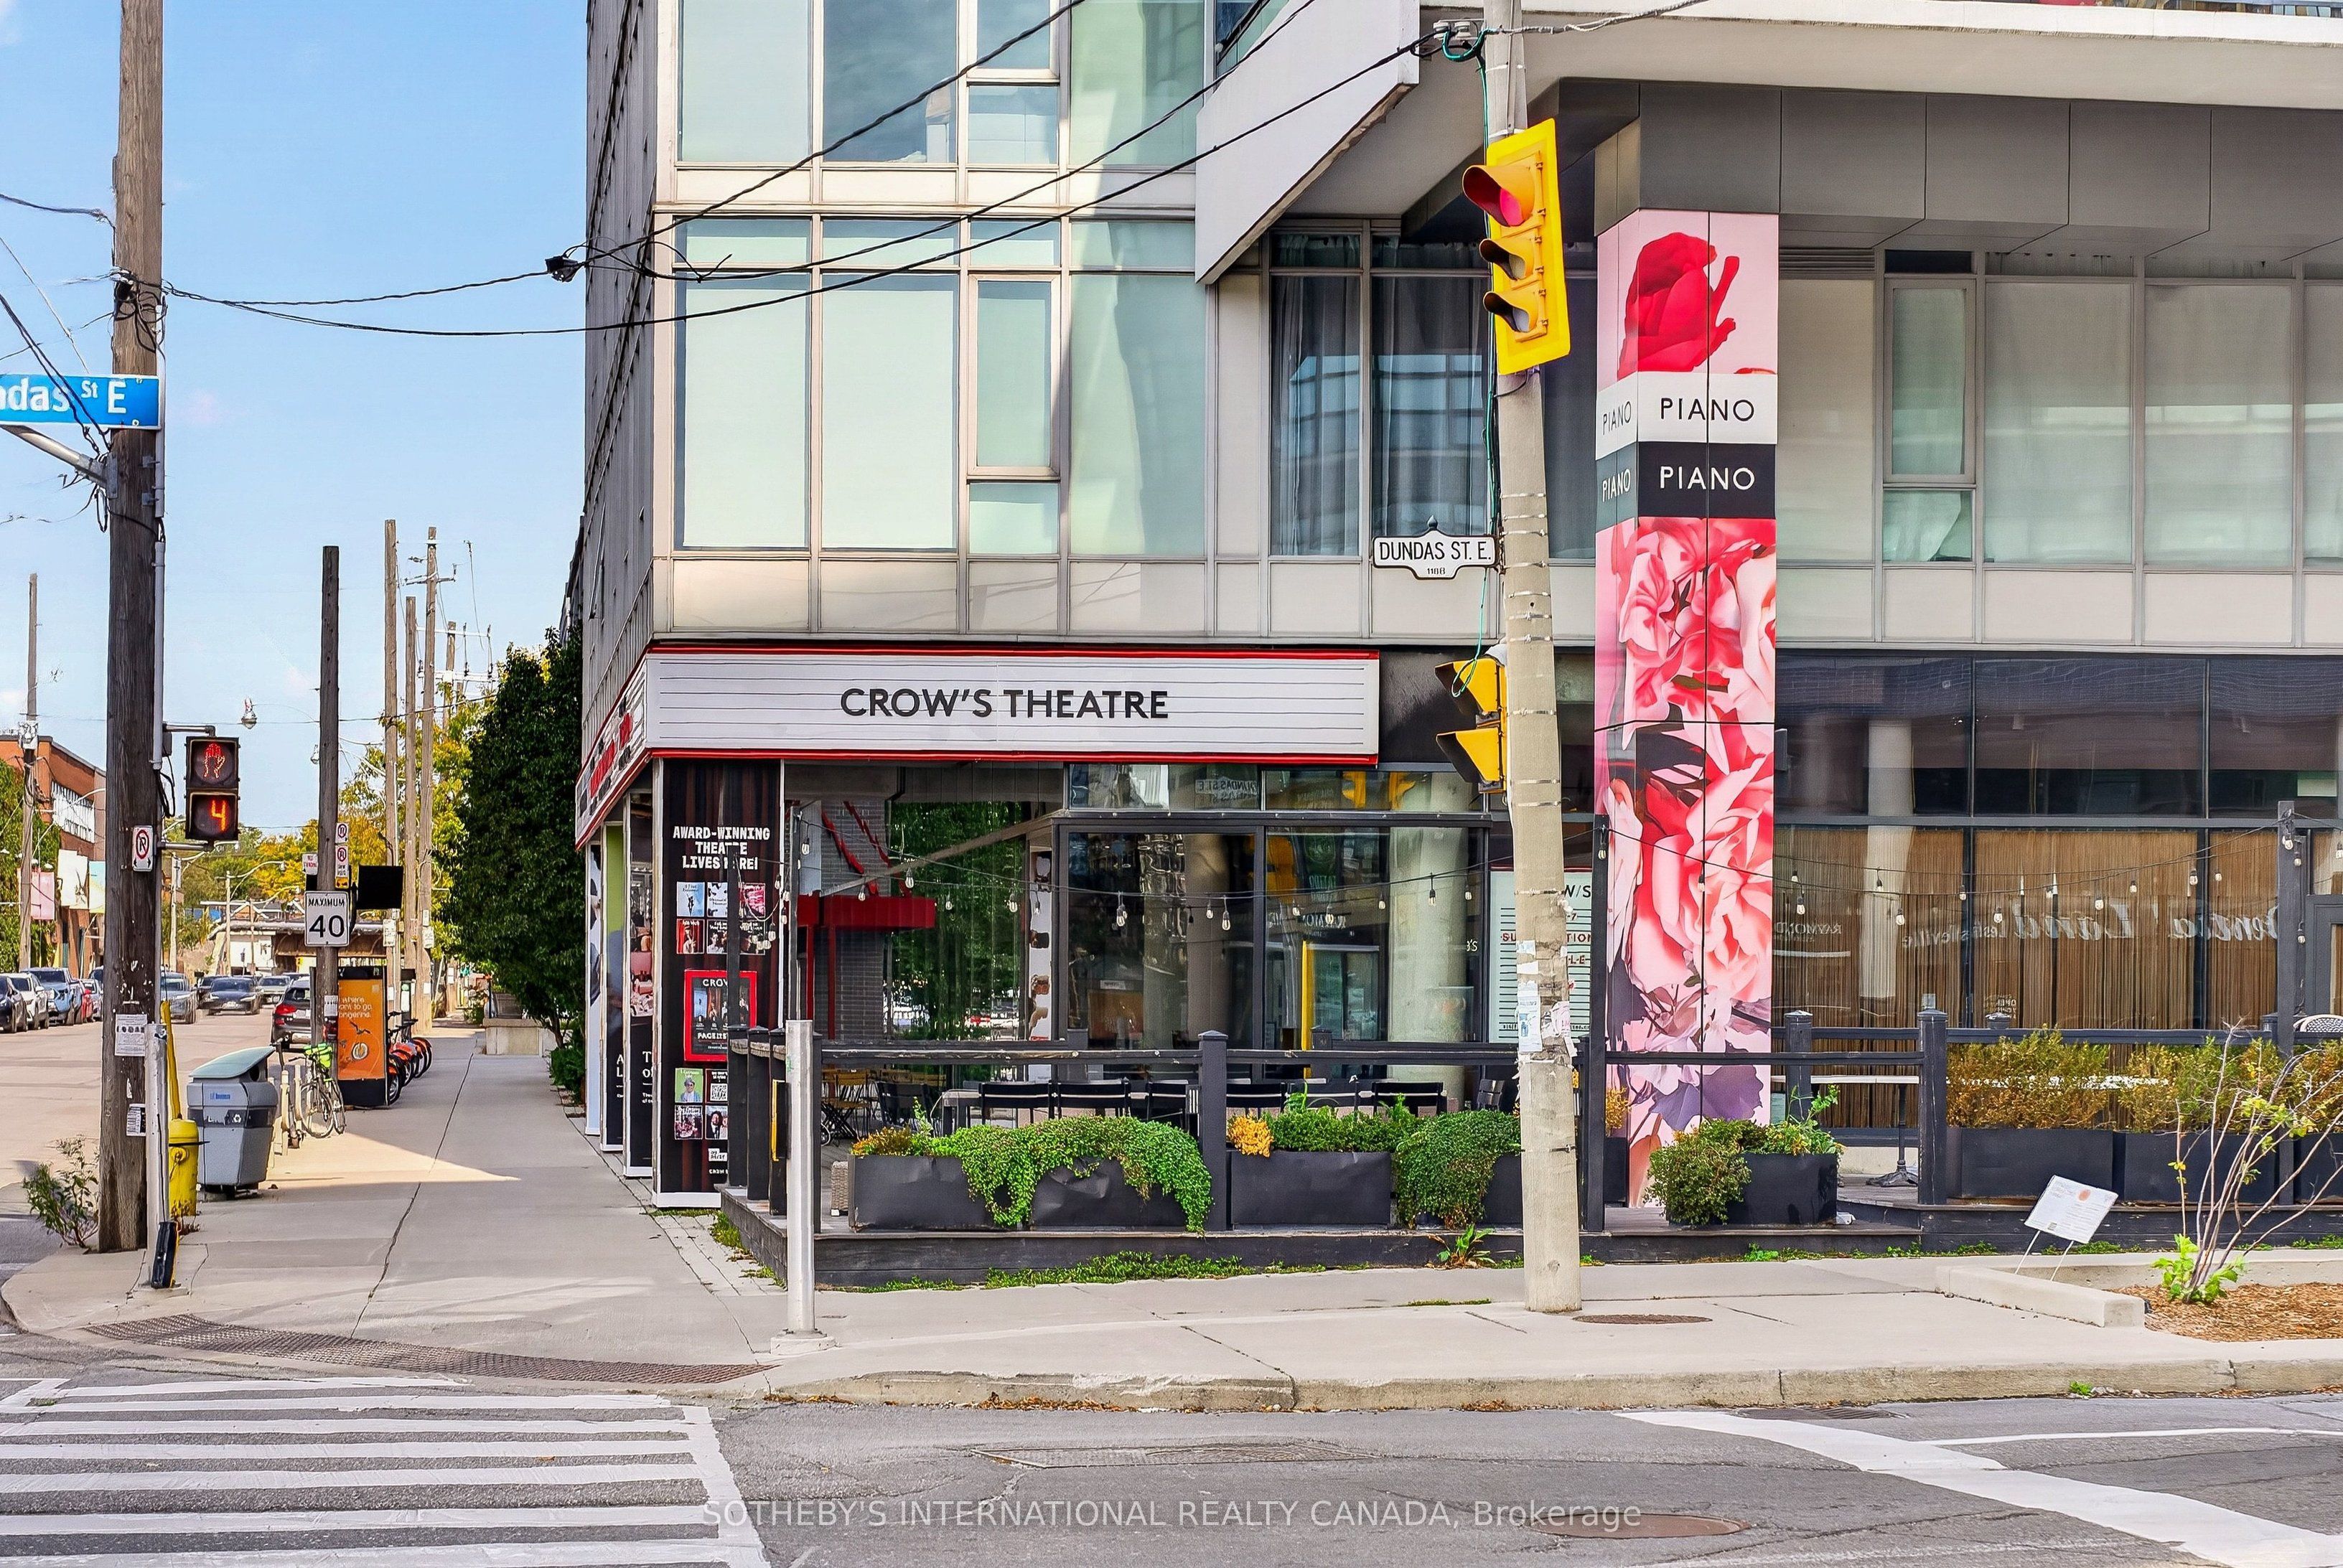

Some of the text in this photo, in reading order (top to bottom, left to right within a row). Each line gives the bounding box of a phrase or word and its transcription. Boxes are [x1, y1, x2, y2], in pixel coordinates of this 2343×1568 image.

[81, 380, 98, 398] St
[108, 380, 126, 413] E
[1602, 400, 1632, 436] PIANO
[1660, 398, 1754, 422] PIANO
[1601, 468, 1632, 502] PIANO
[1660, 466, 1755, 490] PIANO
[1380, 541, 1491, 560] DUNDAS ST. E.
[841, 687, 1169, 718] CROW'S THEATRE
[211, 799, 227, 832] 4
[673, 826, 770, 840] AWARD-WINNING
[683, 855, 720, 869] LIVES
[309, 915, 345, 938] 40
